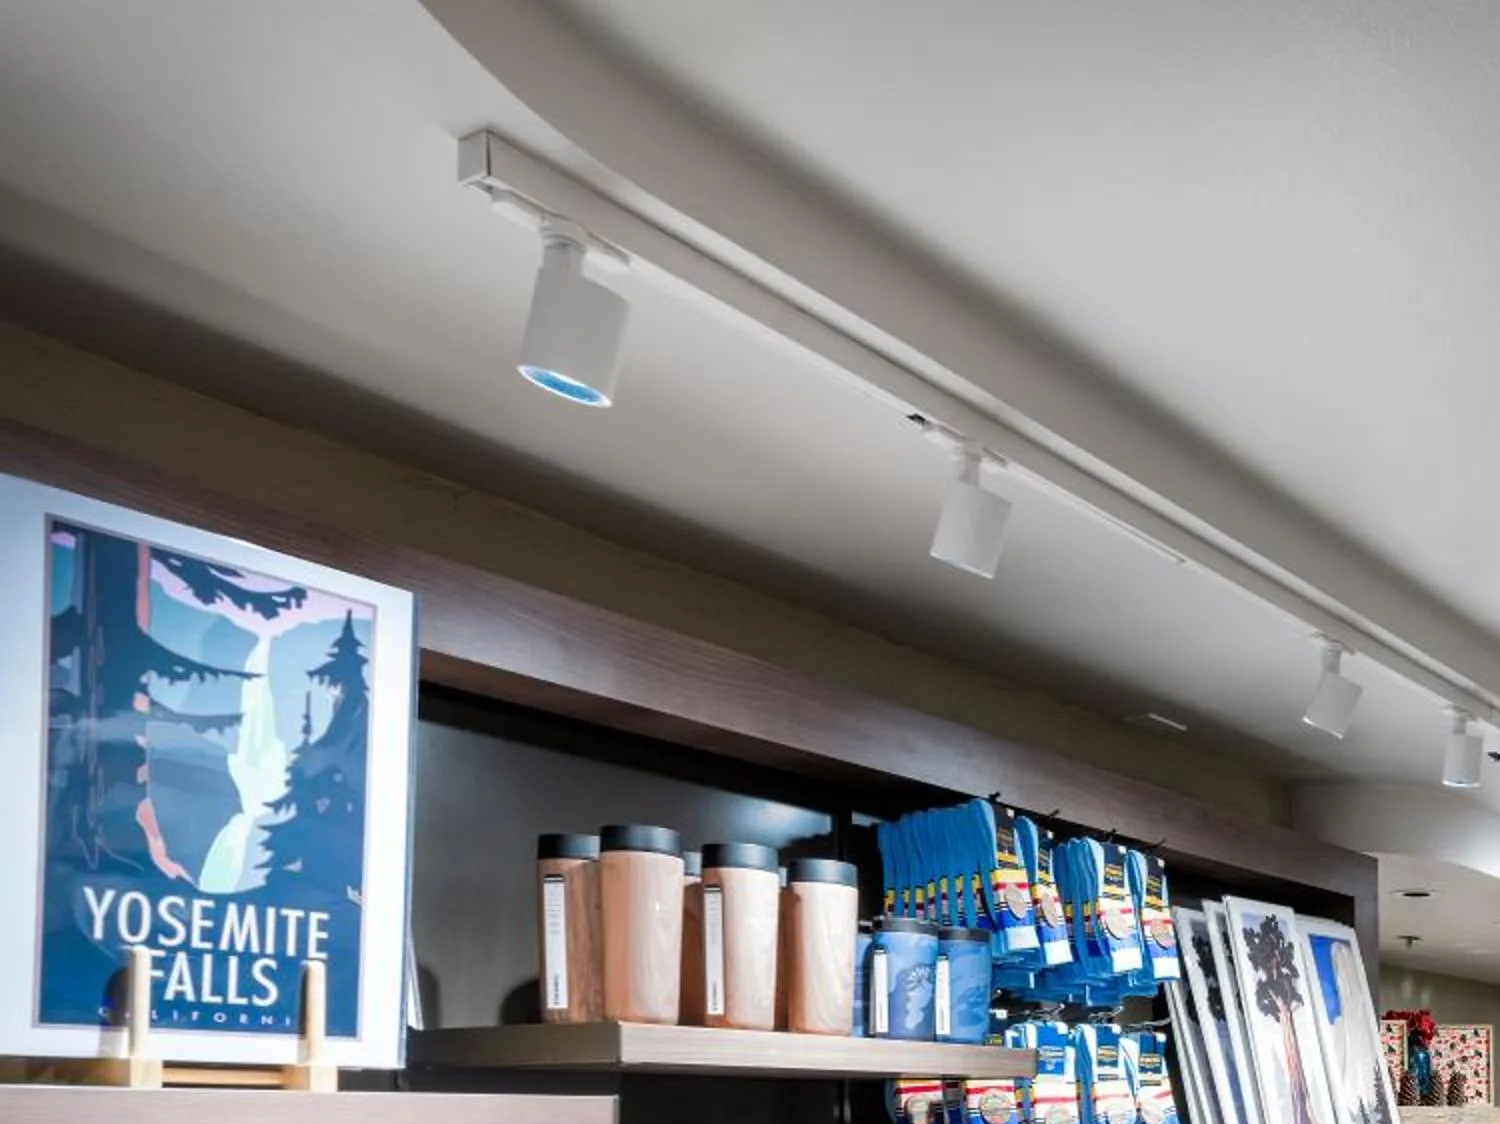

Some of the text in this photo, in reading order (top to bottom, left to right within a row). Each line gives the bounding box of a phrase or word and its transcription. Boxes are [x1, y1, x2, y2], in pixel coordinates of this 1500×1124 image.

[83, 886, 331, 959] YOSEMITE
[149, 949, 279, 1007] FALLS
[98, 1006, 292, 1026] CLIFORNI
